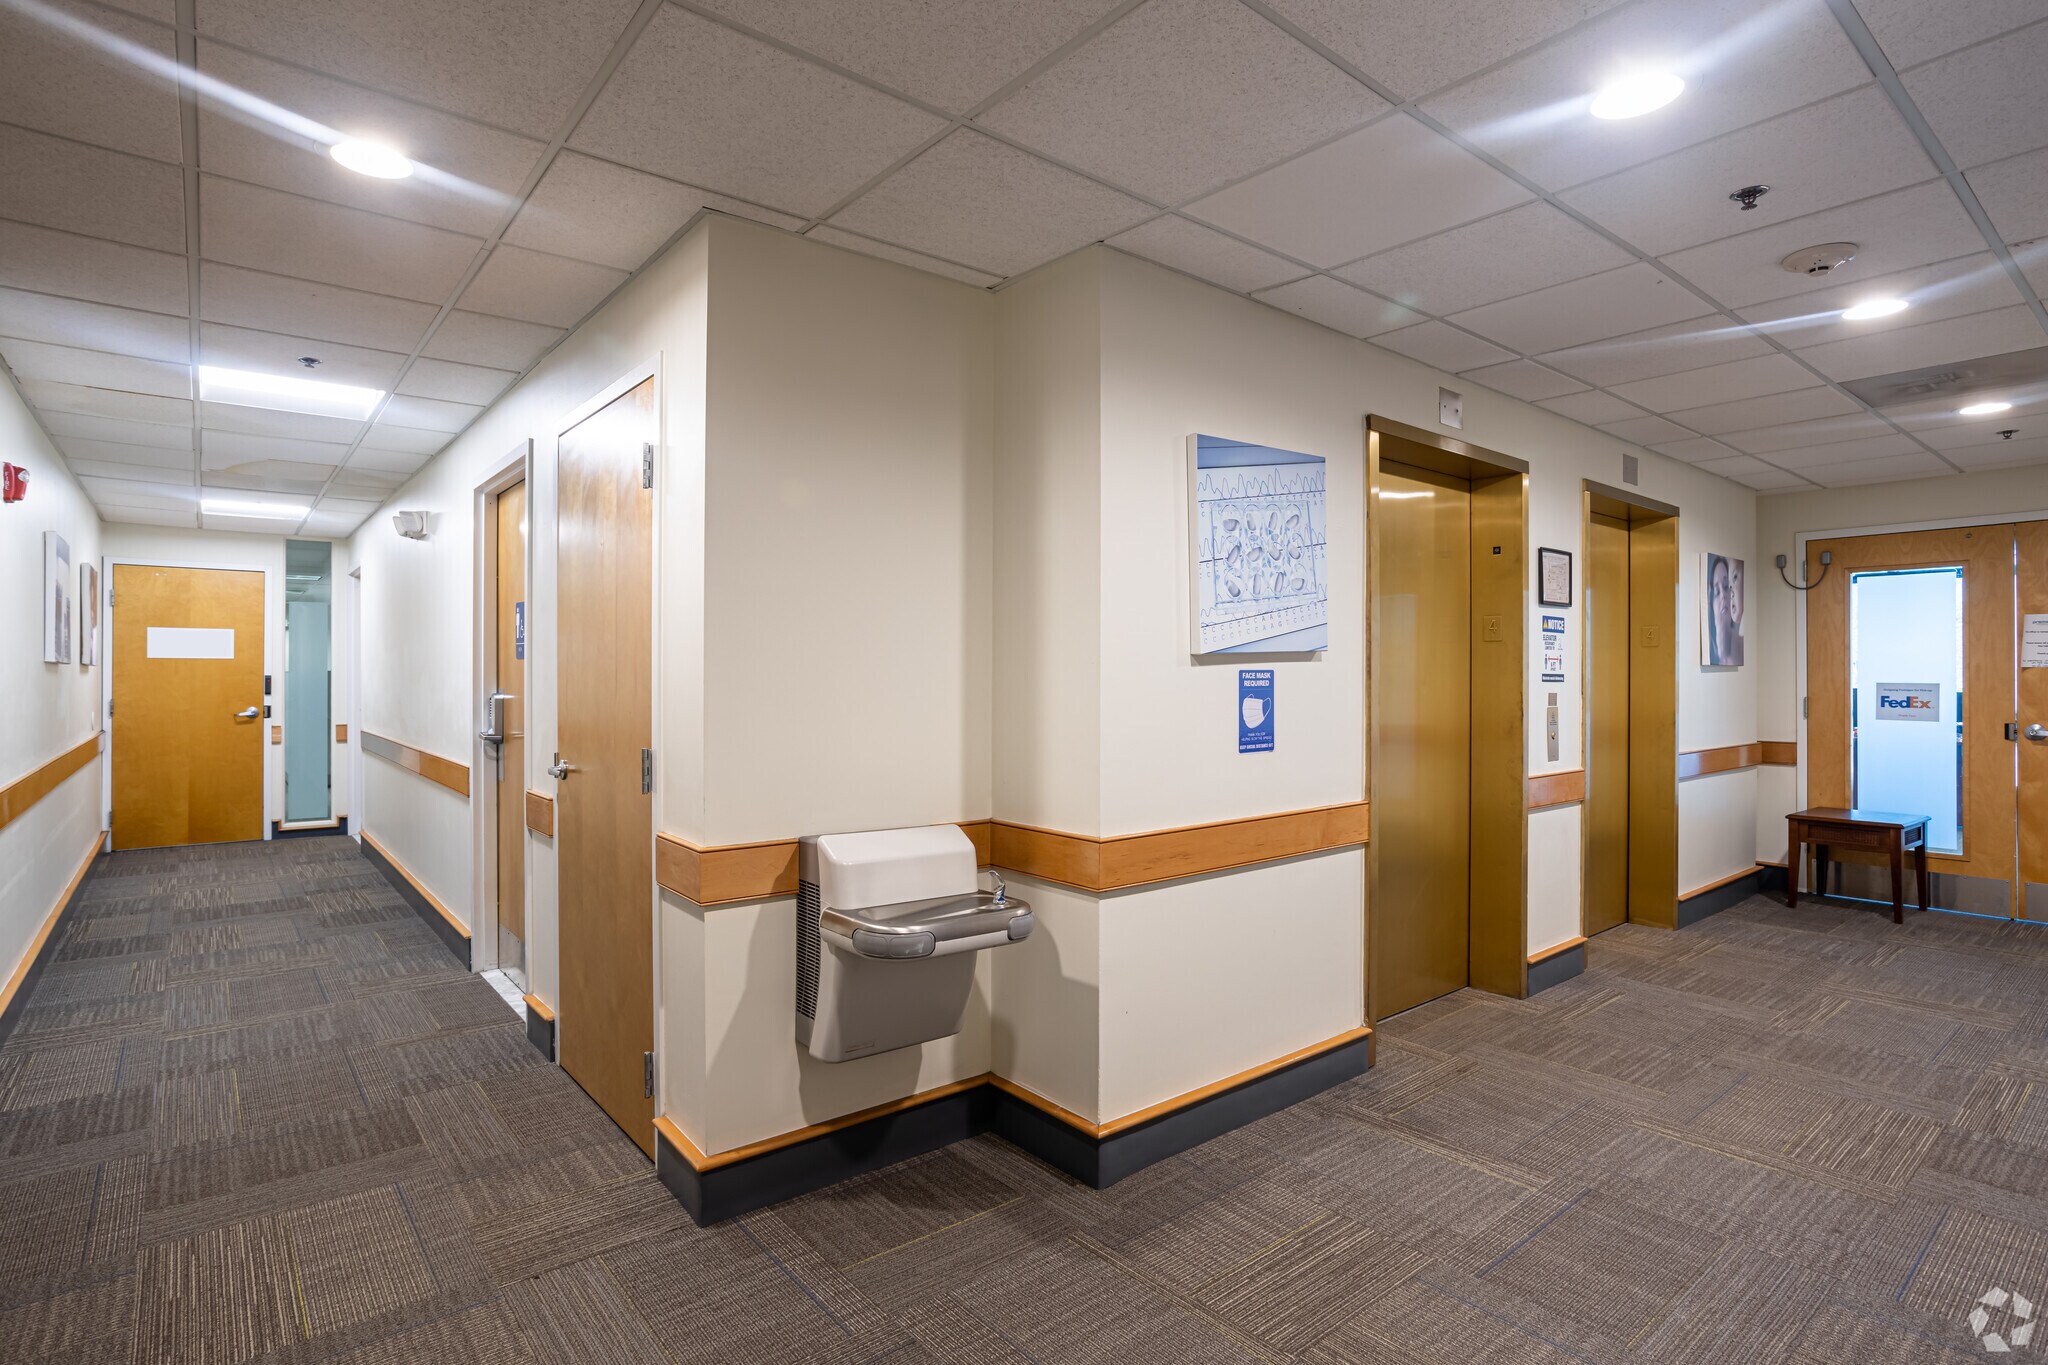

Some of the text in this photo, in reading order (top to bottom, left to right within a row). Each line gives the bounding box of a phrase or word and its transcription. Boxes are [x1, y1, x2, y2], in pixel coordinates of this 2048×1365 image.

[1488, 619, 1498, 632] 4
[1547, 619, 1564, 630] NOTICE
[1880, 695, 1931, 709] FedEx
